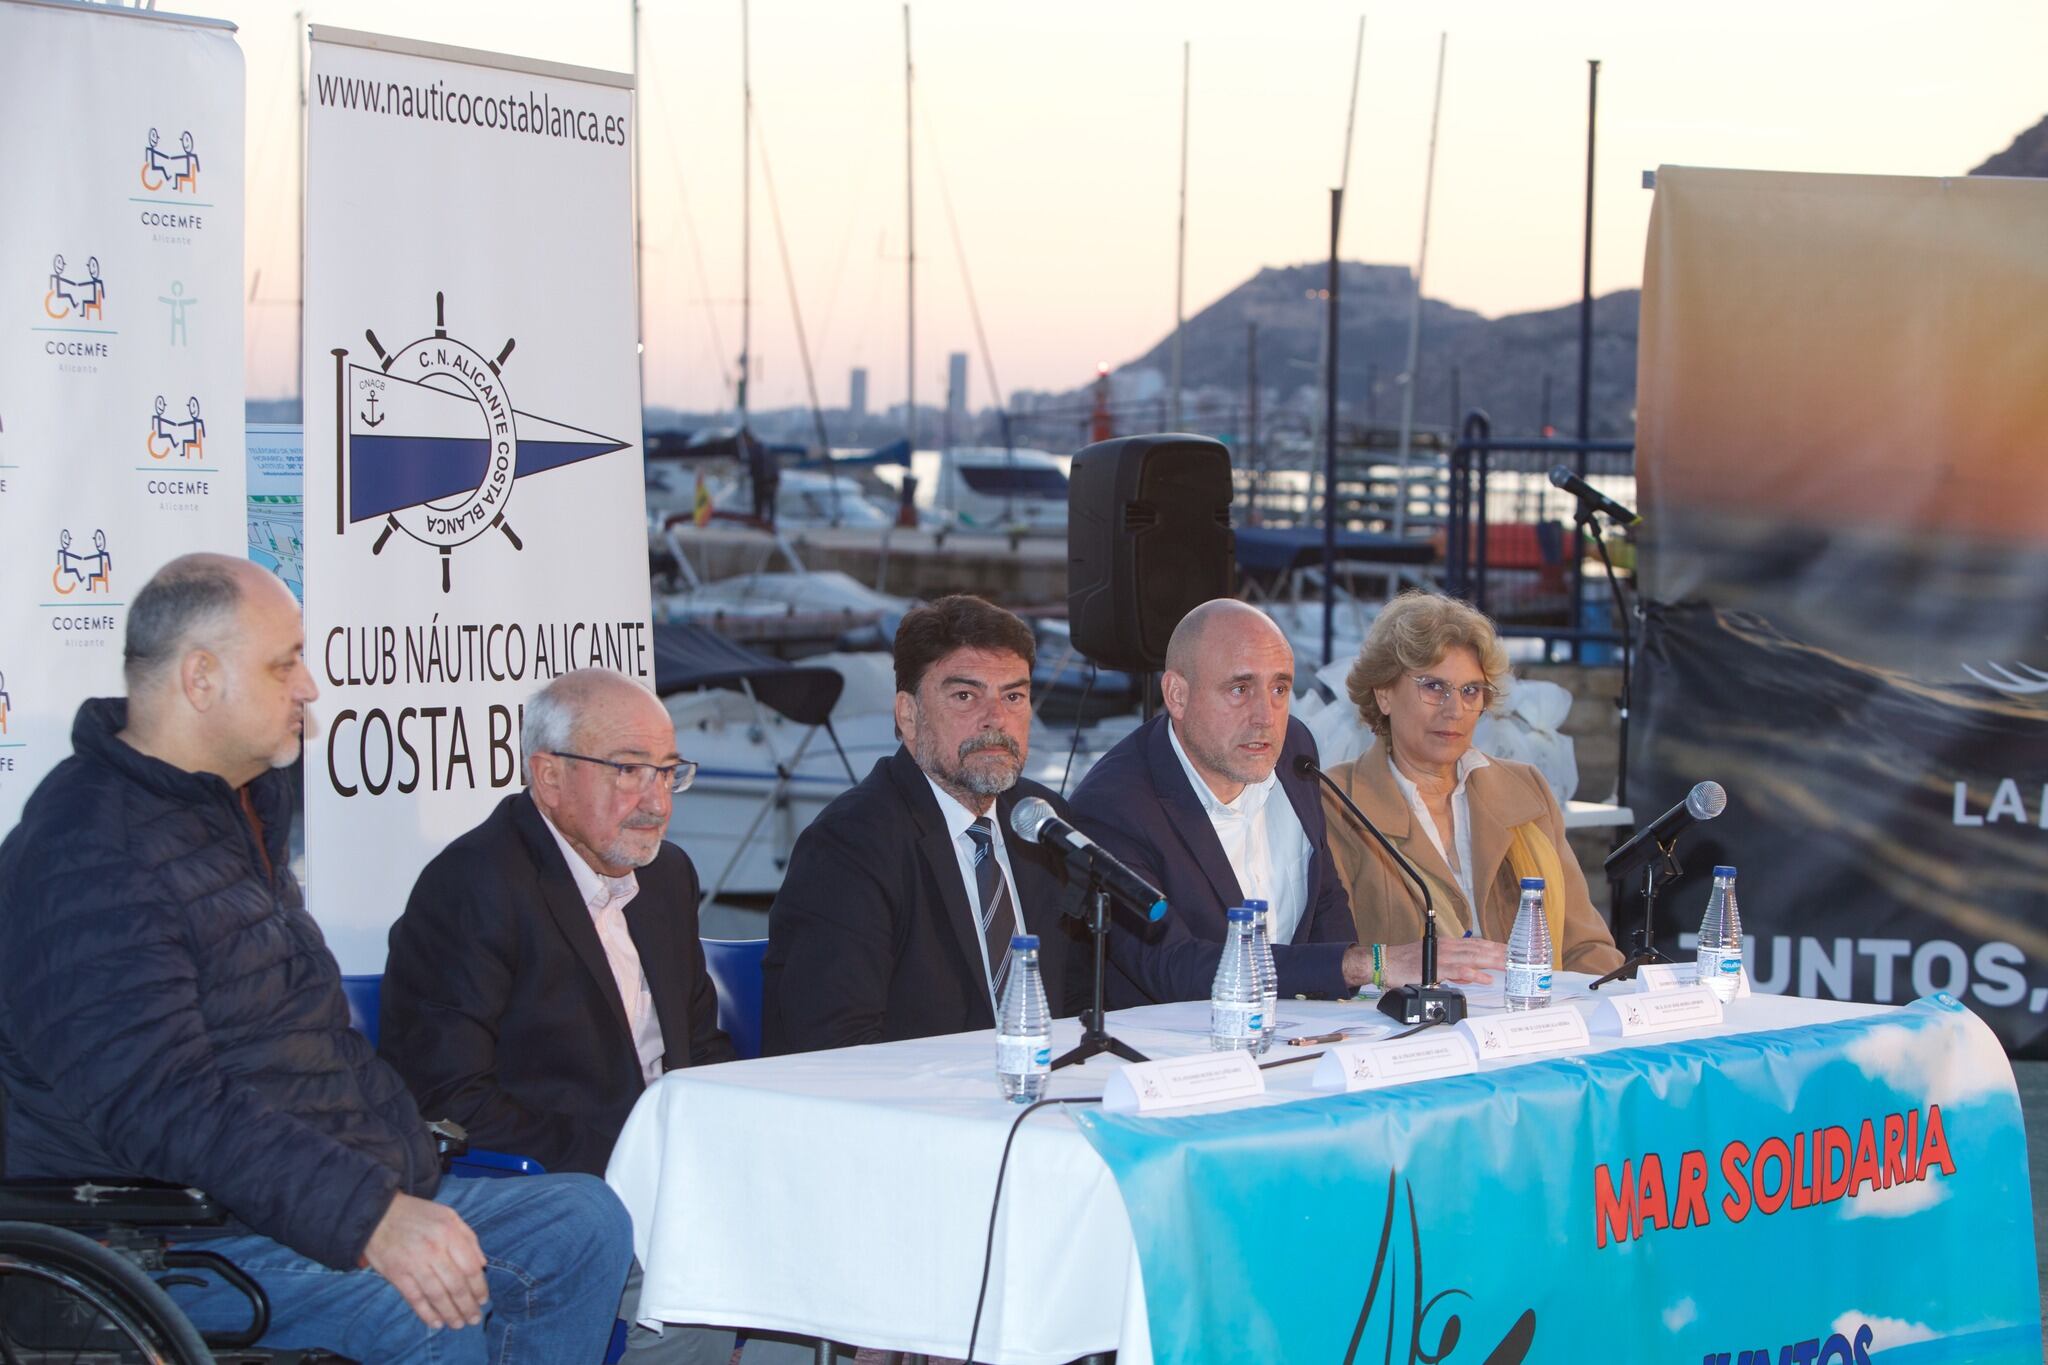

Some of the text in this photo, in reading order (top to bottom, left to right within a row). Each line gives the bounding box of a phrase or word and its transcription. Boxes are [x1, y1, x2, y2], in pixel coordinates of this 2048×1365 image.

[317, 73, 626, 146] www.nauticocostablanca.es
[141, 211, 203, 230] COCEMFE
[152, 233, 192, 245] Alicante
[45, 341, 108, 358] COCEMFE
[58, 364, 98, 375] Alicante
[359, 379, 386, 391] CNACB
[419, 349, 510, 535] C. N. ALICANTE COSTA BLANCA
[147, 480, 209, 495] COCEMFE
[159, 502, 200, 512] Alicante
[52, 616, 115, 631] COCEMFE
[64, 637, 105, 648] Alicante
[325, 612, 648, 687] CLUB NÁUTICO ALICANTE
[327, 705, 476, 798] COSTA
[1953, 778, 2028, 827] LA
[1594, 1103, 1958, 1250] MAR SOLIDARIA
